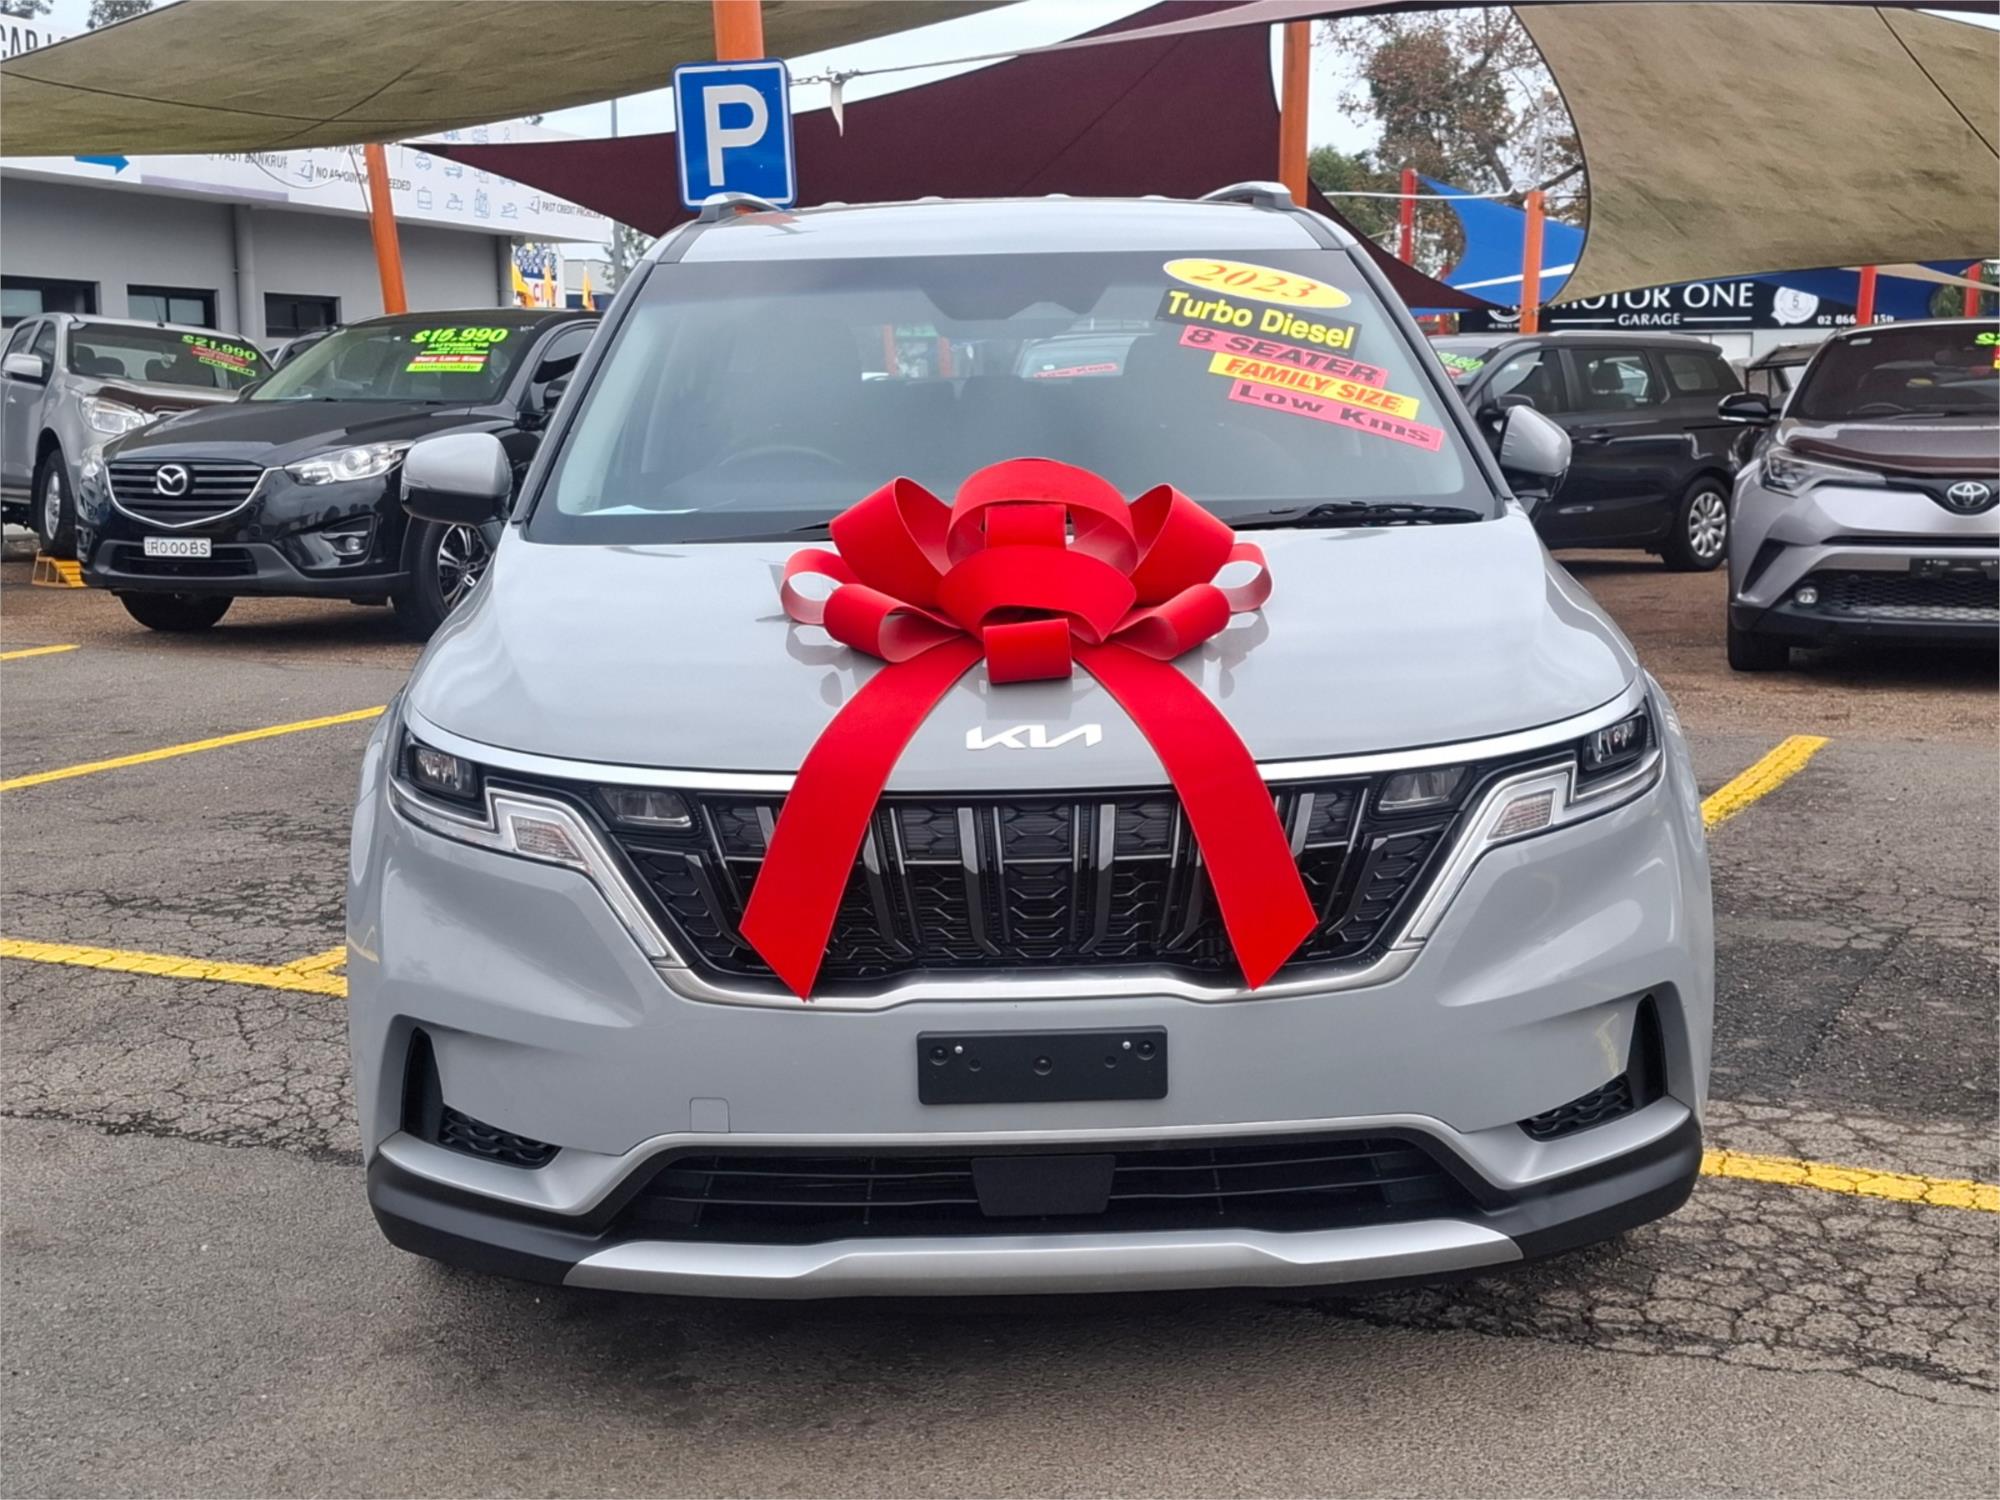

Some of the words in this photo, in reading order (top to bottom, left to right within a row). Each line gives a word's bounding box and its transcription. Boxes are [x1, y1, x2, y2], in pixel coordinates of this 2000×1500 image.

[703, 84, 768, 187] P
[316, 167, 328, 179] NO
[388, 178, 412, 192] EEDED
[1190, 264, 1318, 299] 2023
[1552, 287, 1672, 310] OTOR
[1683, 282, 1755, 308] ONE
[1168, 290, 1253, 327] Turbo
[1259, 308, 1355, 349] Diesel
[1618, 313, 1681, 327] GARAGE
[1817, 315, 1832, 325] 02
[1835, 314, 1857, 325] 866
[1187, 329, 1215, 345] 8
[1225, 336, 1379, 382] SEATER
[1225, 358, 1336, 392] FAMILY
[1337, 383, 1404, 411] SIZE
